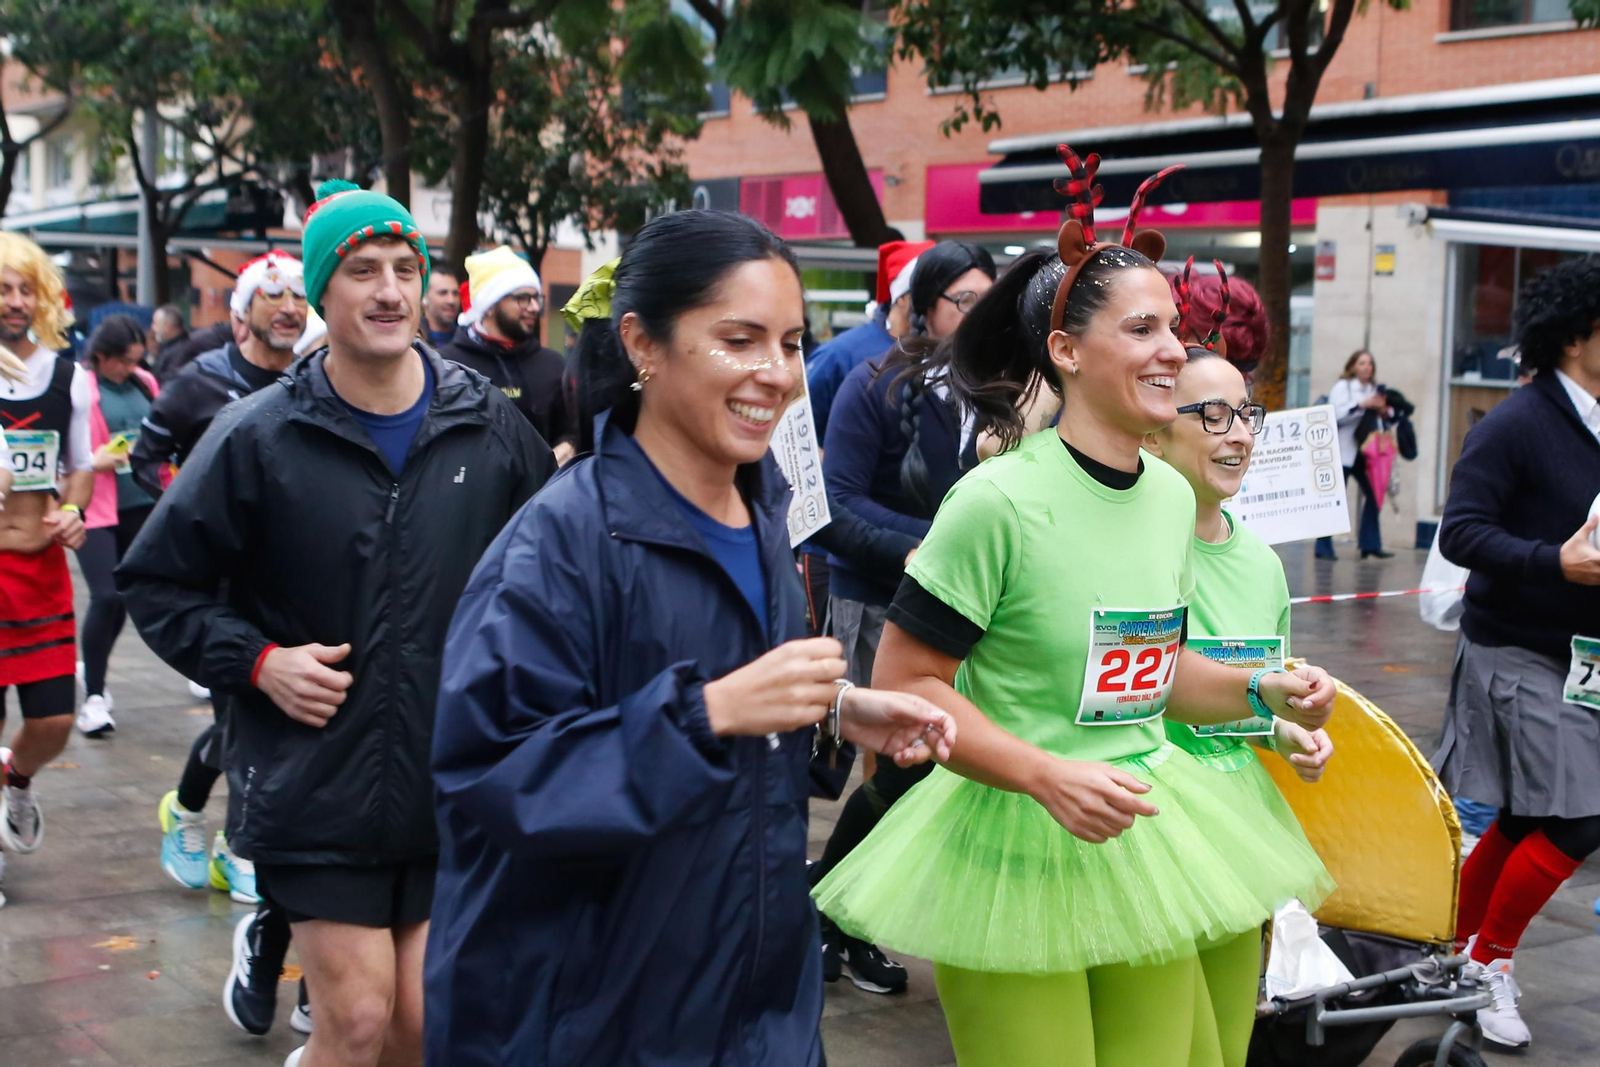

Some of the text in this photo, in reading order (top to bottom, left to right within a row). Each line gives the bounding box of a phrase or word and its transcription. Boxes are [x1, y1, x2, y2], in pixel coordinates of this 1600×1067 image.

[1262, 422, 1301, 441] 712
[797, 409, 817, 490] 19712
[1266, 445, 1304, 455] NACIONAL
[13, 452, 46, 472] 04
[1258, 455, 1292, 466] NAVIDAD
[1320, 473, 1331, 483] 20
[1118, 620, 1158, 637] CARRERA
[1236, 647, 1265, 661] NAVIDAD
[1096, 641, 1179, 692] 227
[1579, 661, 1600, 685] 7
